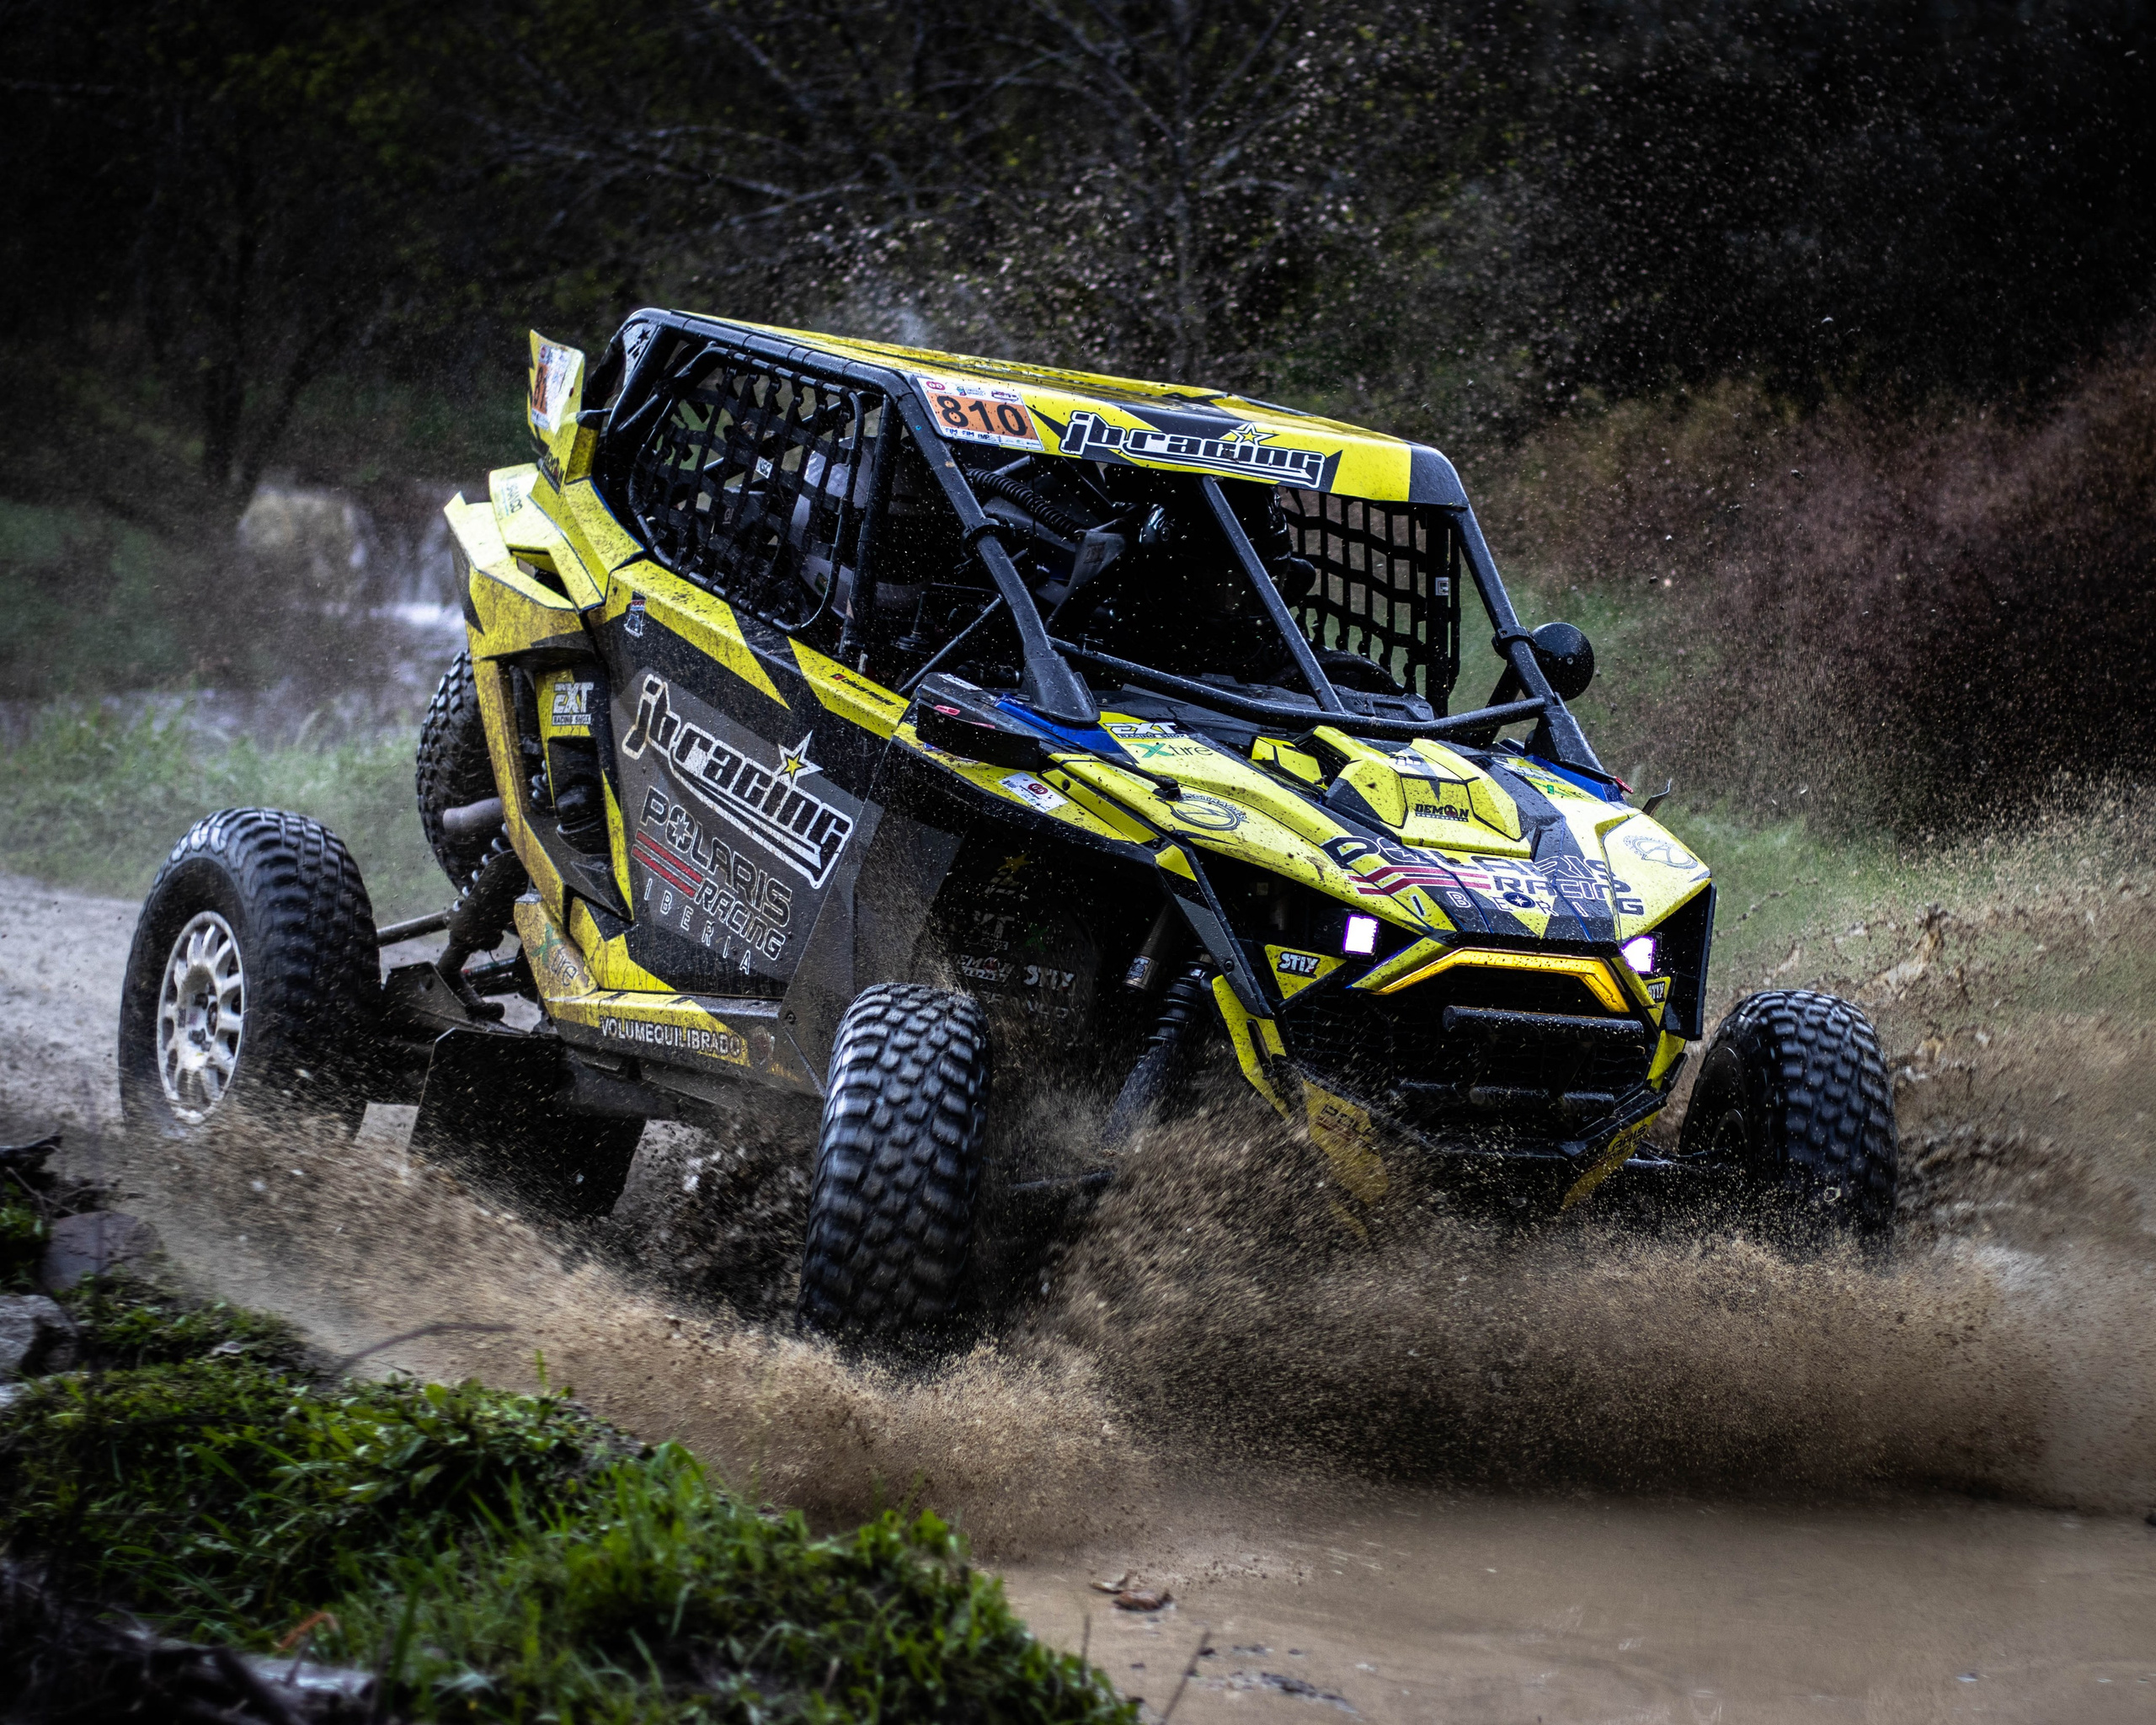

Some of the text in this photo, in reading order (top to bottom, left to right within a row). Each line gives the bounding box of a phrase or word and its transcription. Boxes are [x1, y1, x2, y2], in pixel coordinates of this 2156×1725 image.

[937, 395, 1027, 435] 810
[552, 681, 595, 713] EXT
[1104, 722, 1177, 734] EXT
[1415, 804, 1469, 818] DEMON
[640, 785, 793, 927] POLARIS
[1320, 836, 1616, 880] POLARIS
[1493, 875, 1645, 916] RACING
[643, 878, 752, 975] IBERIA
[694, 878, 787, 961] RACING
[1279, 953, 1319, 973] STIX
[599, 1015, 742, 1057] VOLUMEQUILIBRADO
